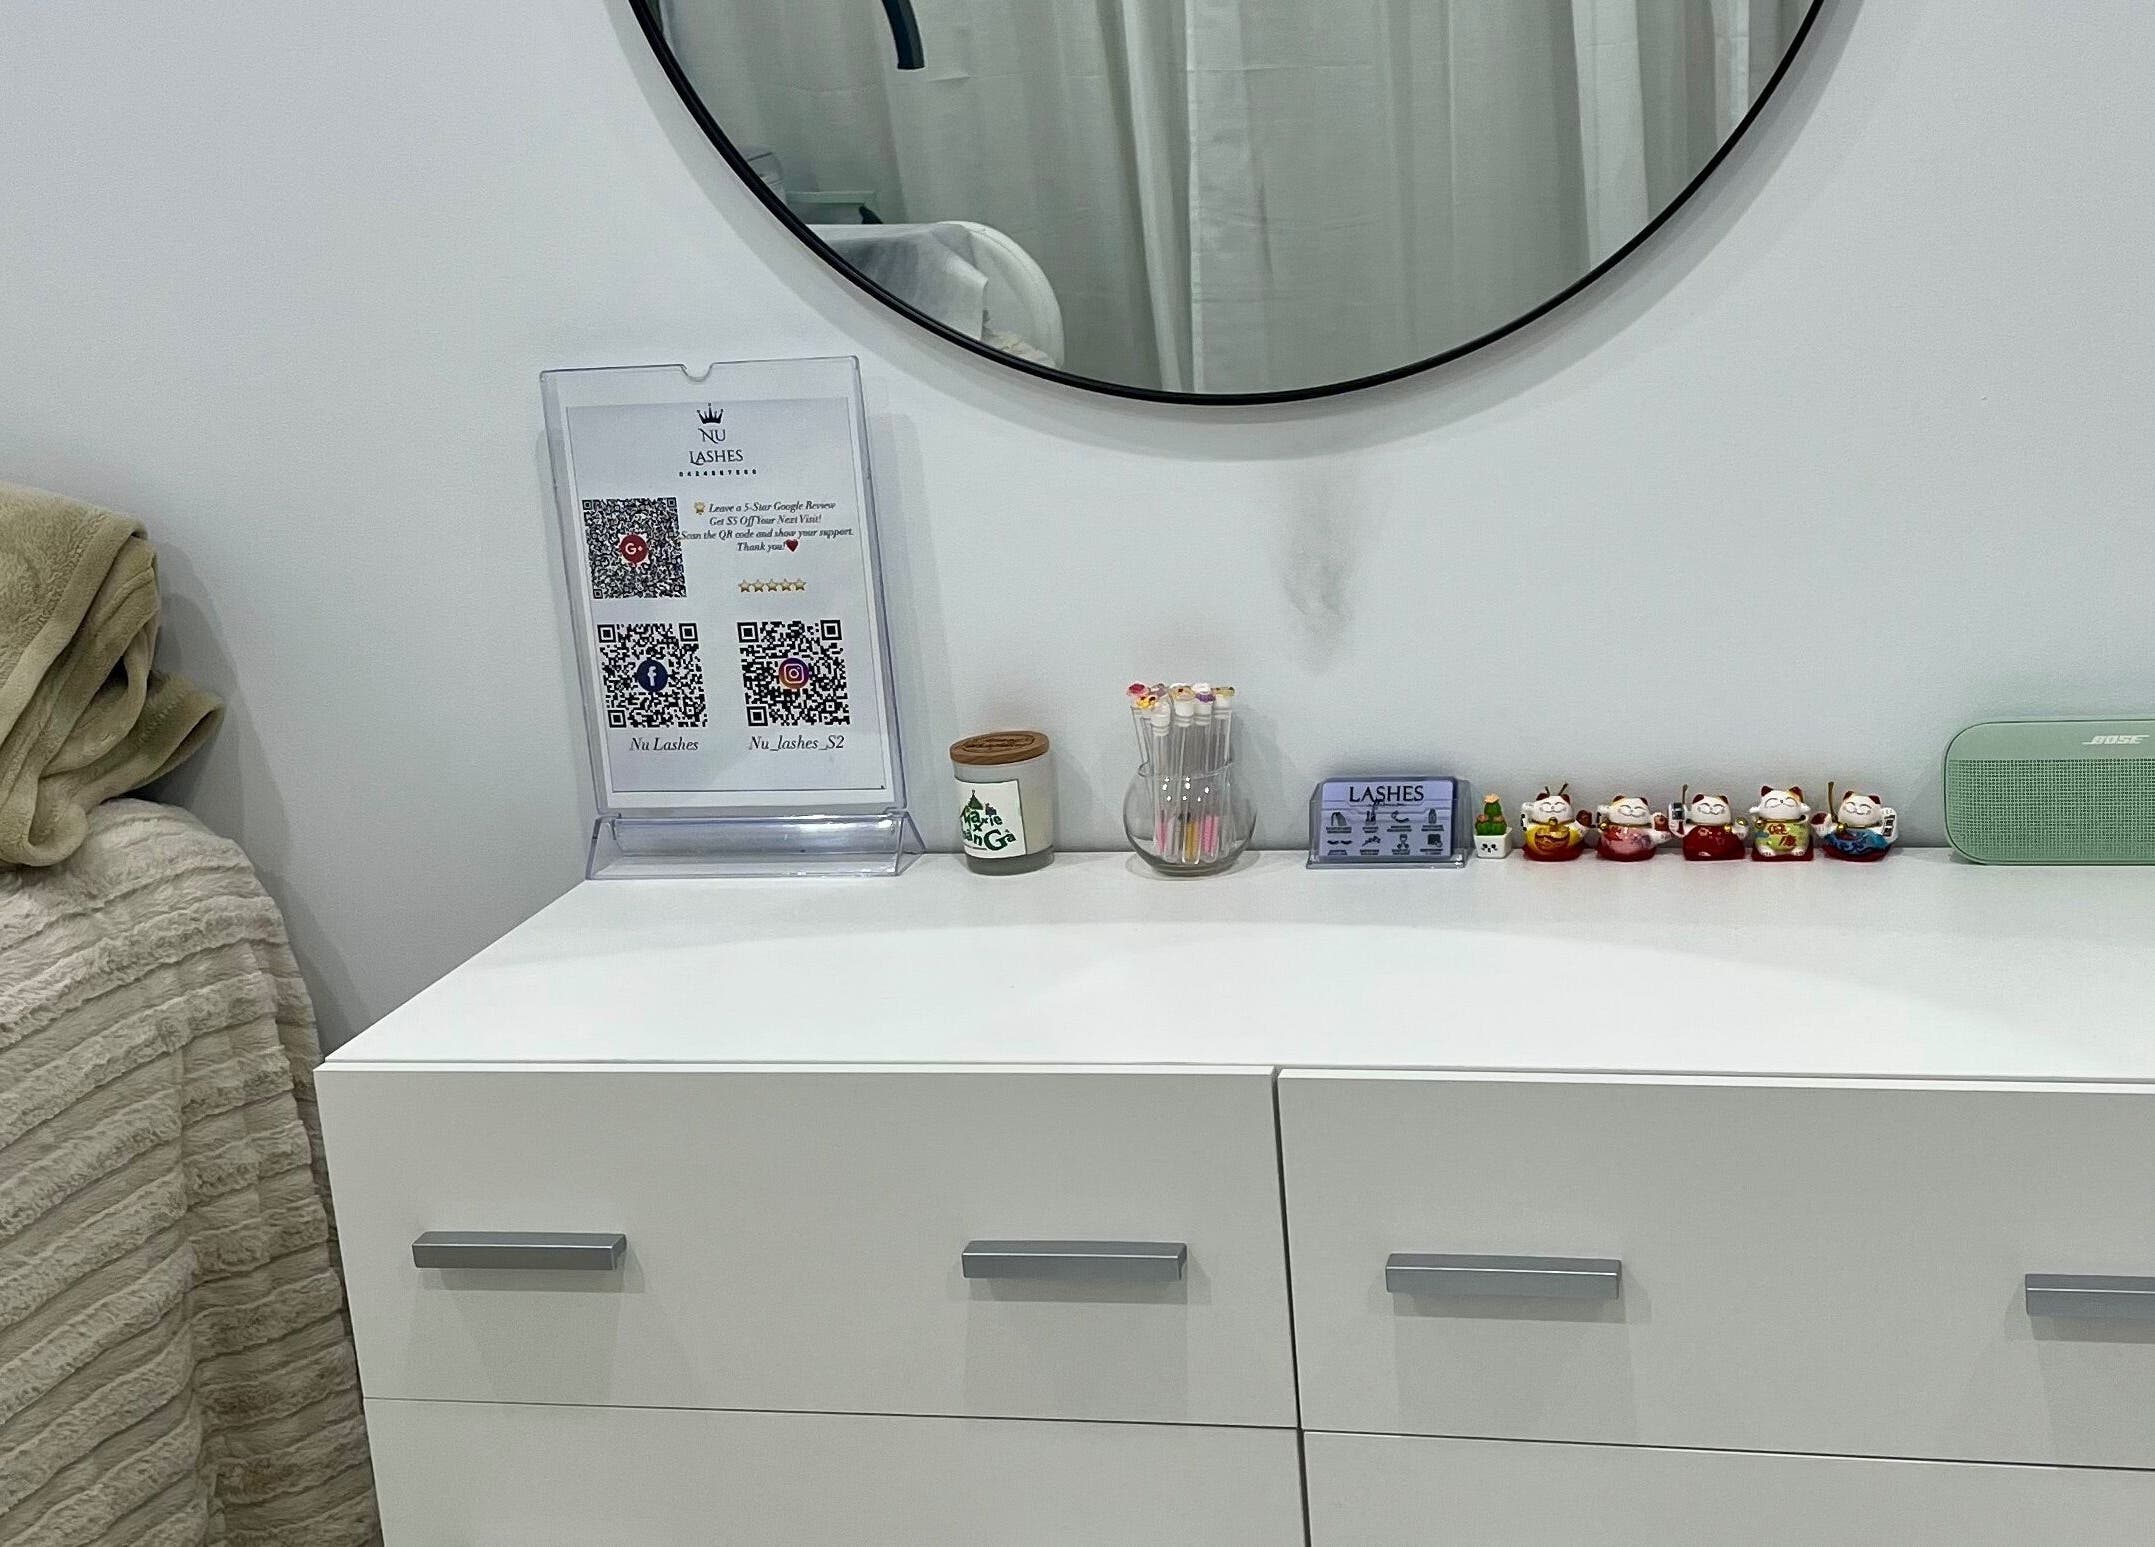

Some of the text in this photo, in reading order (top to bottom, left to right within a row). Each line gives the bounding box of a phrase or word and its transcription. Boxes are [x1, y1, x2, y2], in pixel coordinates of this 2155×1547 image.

[698, 428, 726, 444] NU
[689, 449, 744, 466] LASHES
[709, 502, 734, 512] Leave
[744, 501, 772, 512] 5-Star
[773, 500, 803, 513] Google
[805, 500, 836, 510] Review
[709, 516, 724, 526] Get
[740, 515, 755, 527] Off
[777, 514, 798, 524] Next
[681, 530, 701, 540] Scan
[703, 529, 716, 539] the
[719, 529, 733, 540] QR
[735, 528, 754, 539] code
[756, 528, 773, 538] and
[774, 528, 796, 537] show
[797, 529, 817, 539] your
[737, 541, 765, 552] Thank
[630, 737, 699, 750] Nu Lashes
[749, 735, 845, 751] Nu_lashes_S2
[2081, 734, 2150, 745] BOSE
[1349, 785, 1424, 802] LASHES
